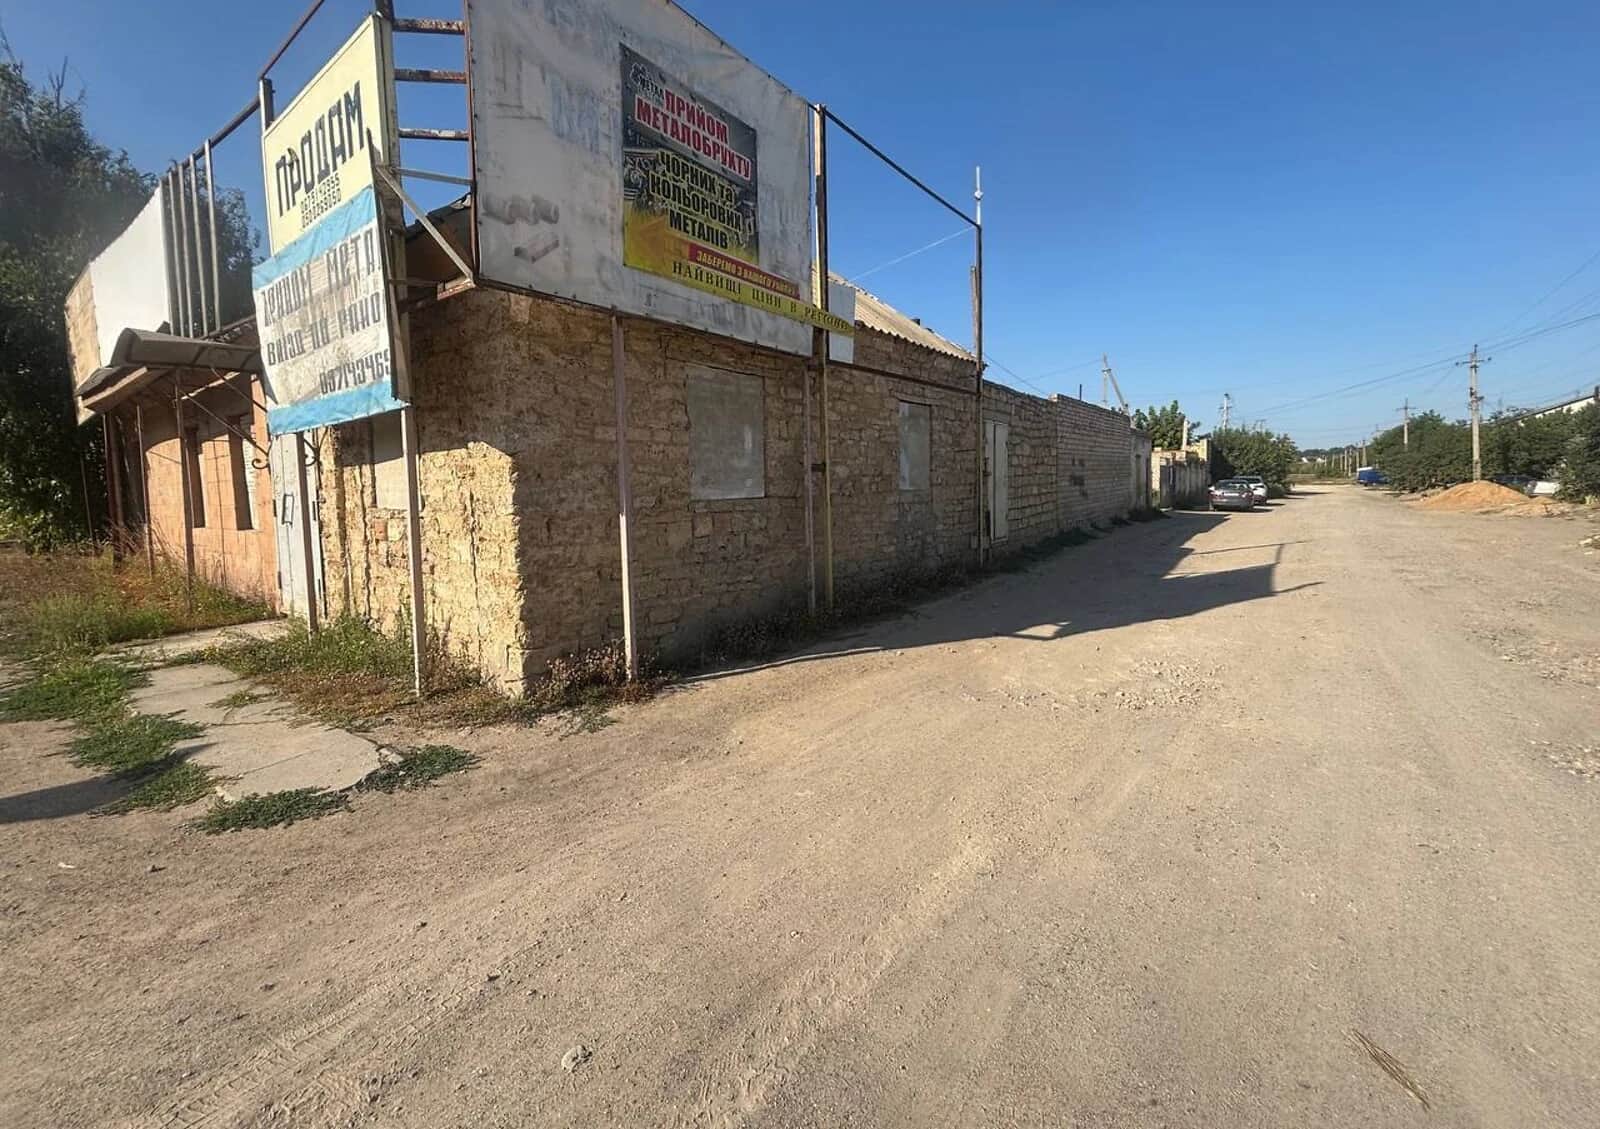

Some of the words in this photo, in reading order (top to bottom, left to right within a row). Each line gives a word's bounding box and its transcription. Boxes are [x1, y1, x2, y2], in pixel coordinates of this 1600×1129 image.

[636, 95, 751, 180] МЕТАЛОБРУКТУ
[665, 89, 729, 144] ПРИЙОМ
[276, 80, 365, 217] ПРОДАМ
[657, 149, 717, 196] ЧОРНИХ
[649, 172, 742, 233] КОЛЬОРОВИХ
[669, 207, 729, 250] МЕТАЛІВ
[326, 227, 381, 283] МЕТА
